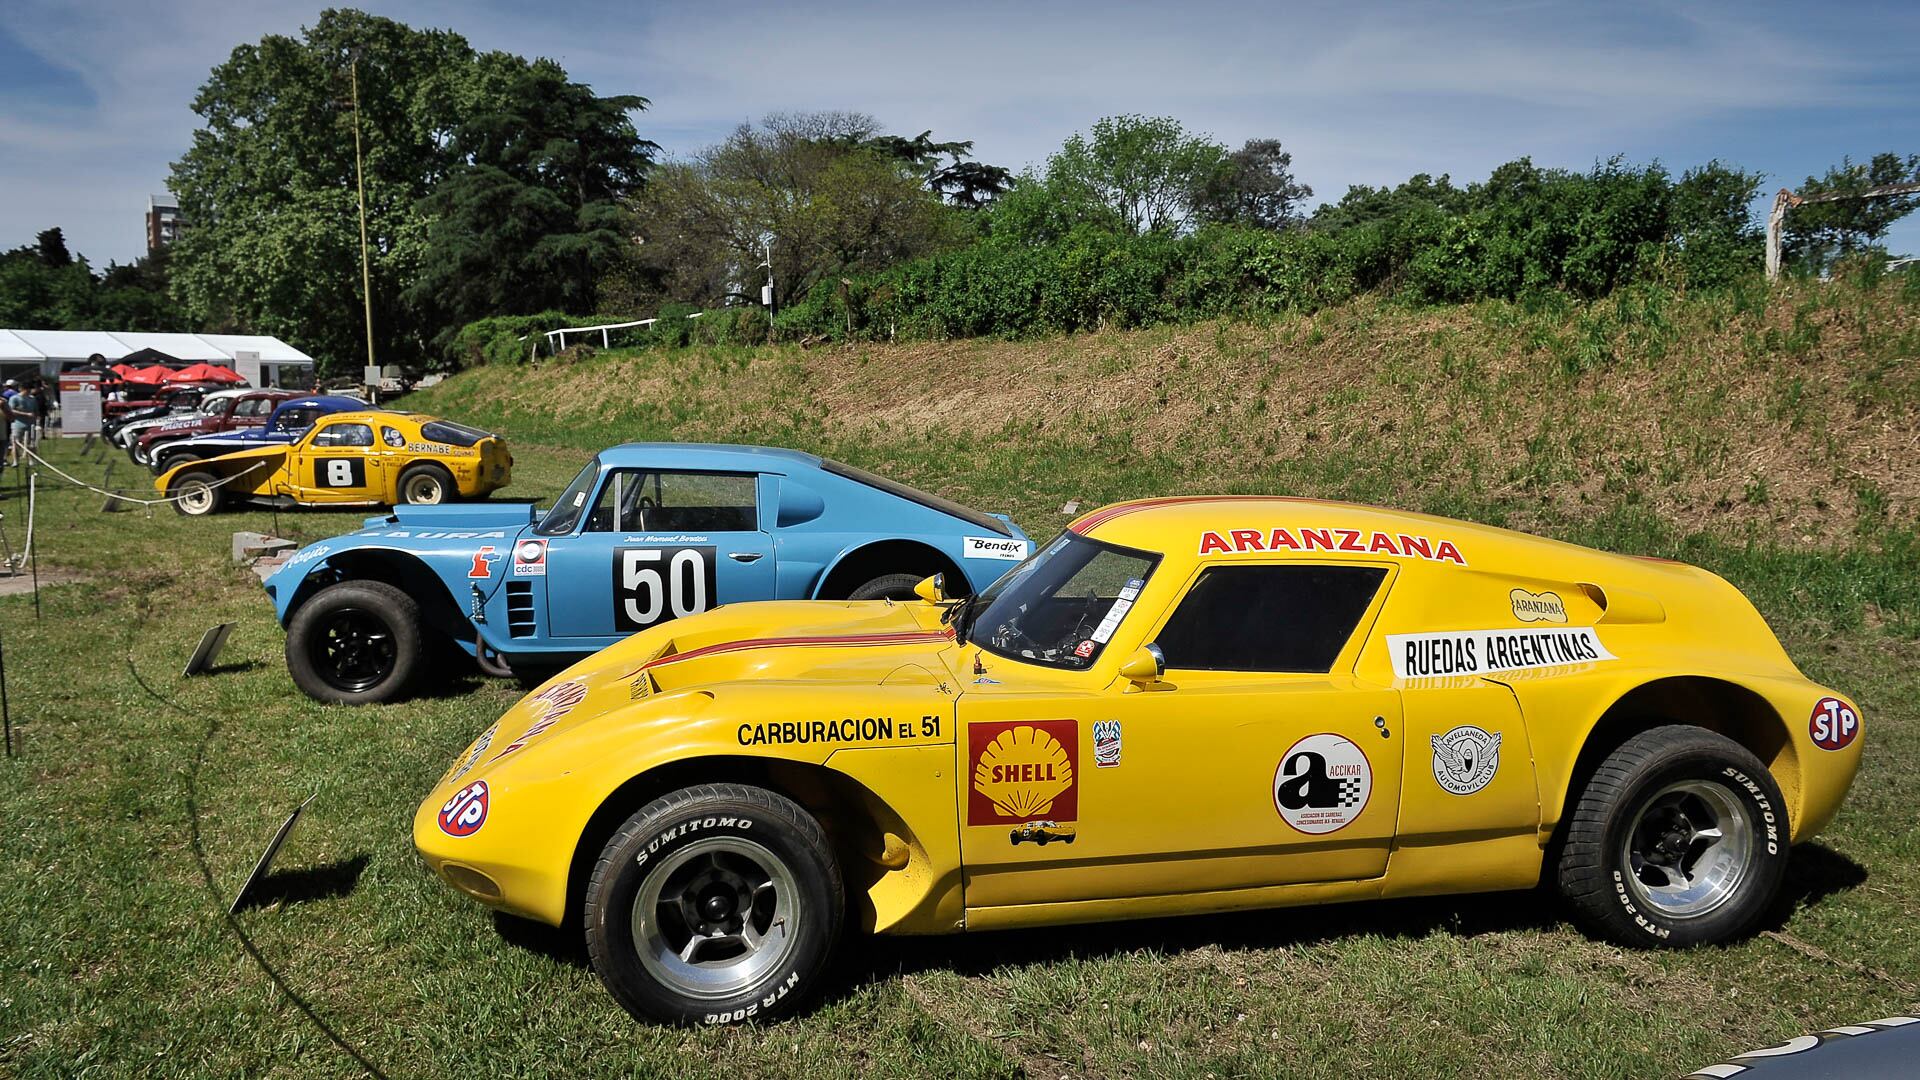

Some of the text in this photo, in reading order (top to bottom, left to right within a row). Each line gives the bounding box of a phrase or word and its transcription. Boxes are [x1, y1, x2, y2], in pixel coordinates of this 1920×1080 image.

[327, 460, 353, 486] 8
[969, 539, 1022, 553] Bendix
[1199, 528, 1467, 566] ARANZANA
[516, 564, 533, 573] cdc
[623, 548, 706, 624] 50
[1516, 600, 1562, 615] ARANZANA
[1406, 633, 1599, 676] RUEDAS ARGENTINAS
[737, 715, 941, 746] CARBURACION EL 51
[1445, 730, 1488, 746] AVELLANEDA
[1814, 700, 1856, 743] STP
[992, 763, 1057, 783] SHELL
[1329, 764, 1361, 777] ACCIKAR
[1437, 764, 1495, 792] AUTOMOVIL CLUB
[441, 782, 484, 828] STP
[1722, 766, 1778, 855] SUMITOMO
[637, 817, 752, 866] SUMITOMO
[1613, 870, 1637, 914] 2000
[705, 971, 800, 1025] HTR 2000
